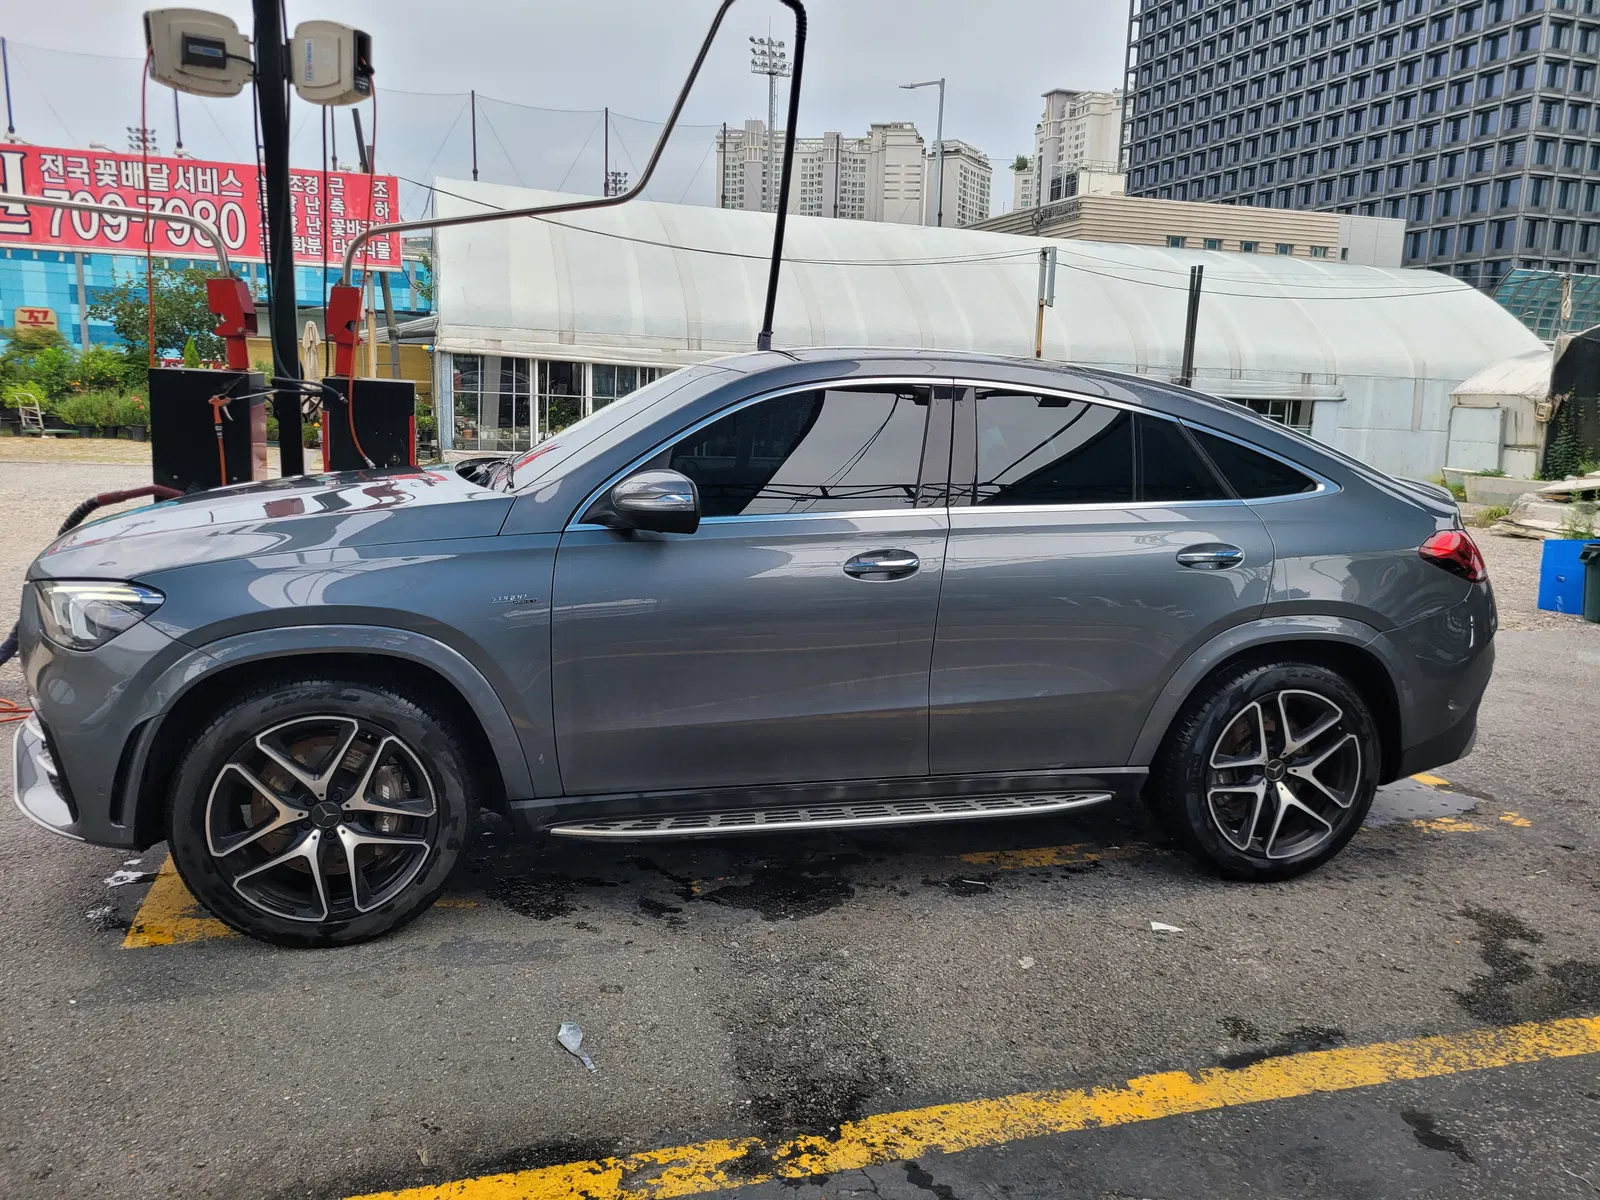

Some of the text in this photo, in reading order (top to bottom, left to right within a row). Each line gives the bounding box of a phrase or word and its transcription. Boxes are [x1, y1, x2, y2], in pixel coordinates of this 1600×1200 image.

[39, 153, 244, 197] 전국 꽃배달 서비스
[42, 188, 247, 250] 709-7980
